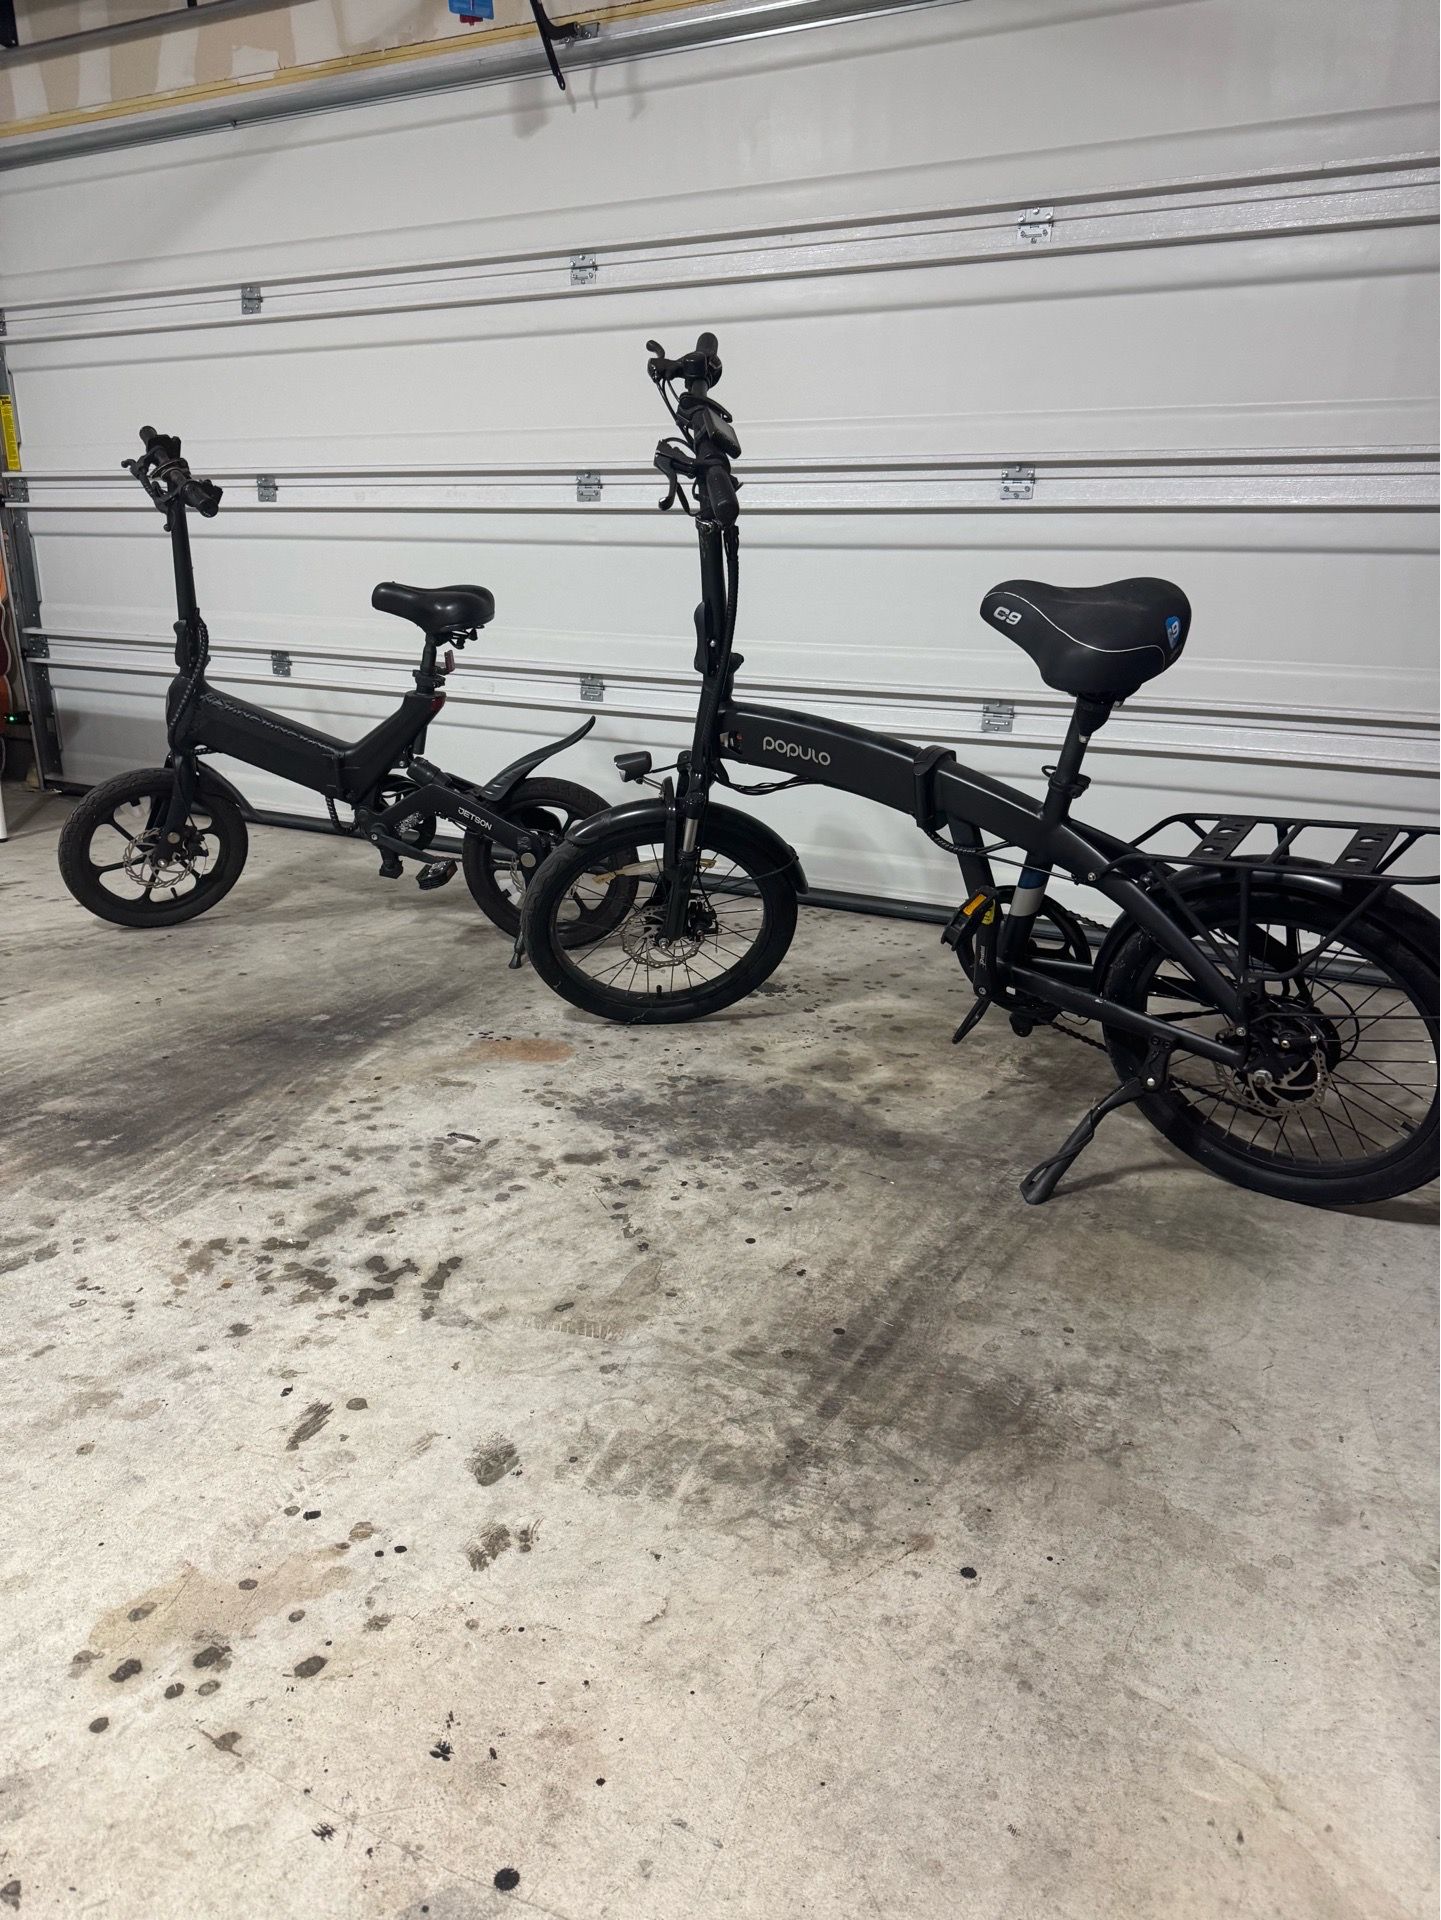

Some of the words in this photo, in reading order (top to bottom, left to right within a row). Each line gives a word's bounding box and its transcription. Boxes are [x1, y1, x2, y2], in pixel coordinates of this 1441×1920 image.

[993, 606, 1022, 626] C9
[763, 736, 831, 766] populo
[458, 806, 492, 831] JETSON
